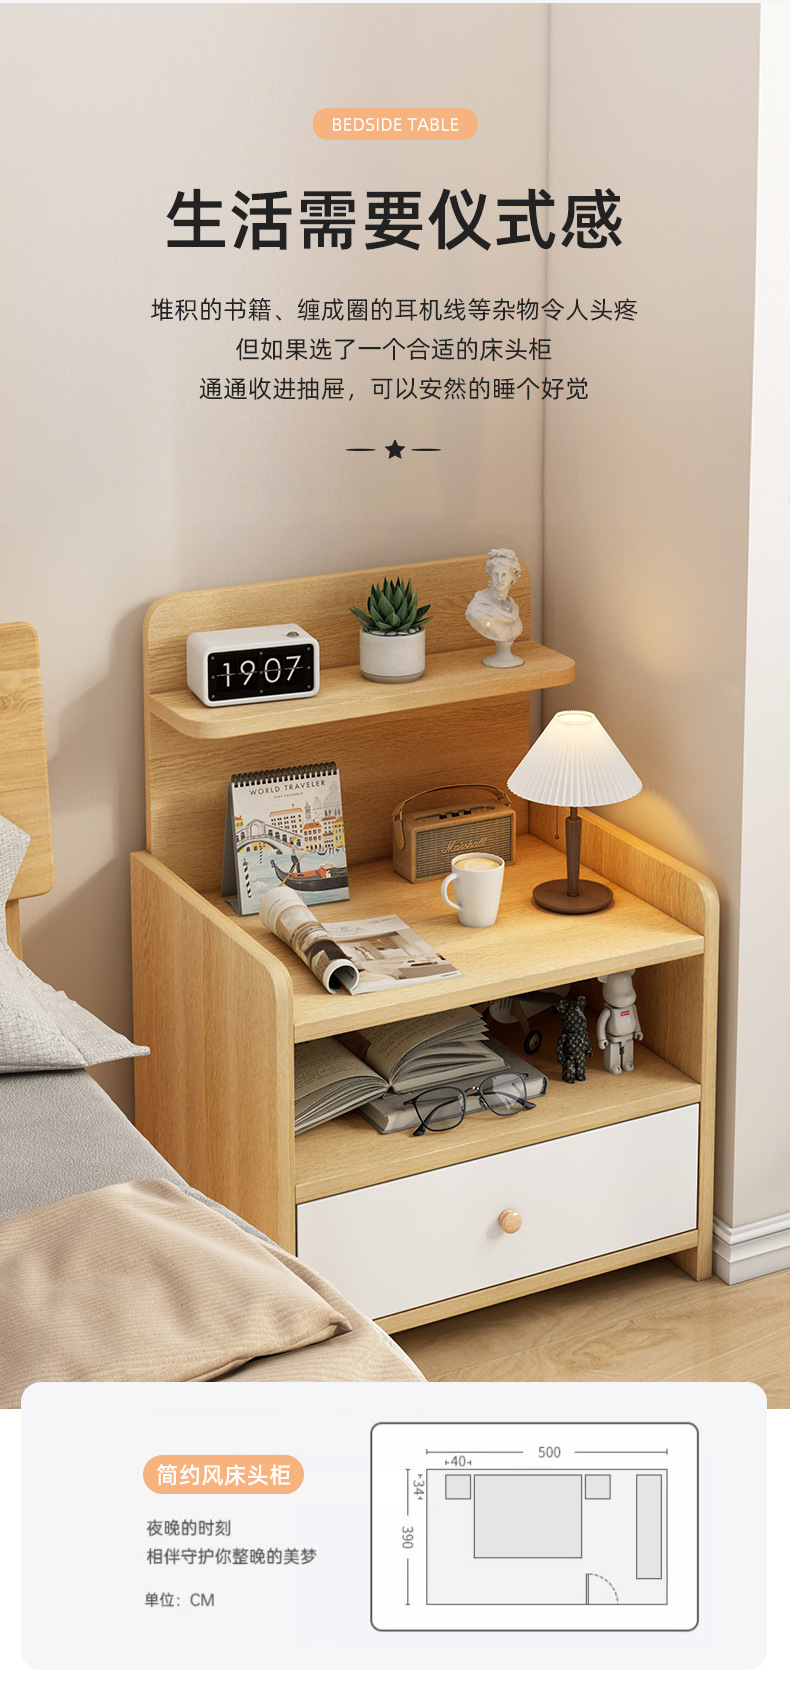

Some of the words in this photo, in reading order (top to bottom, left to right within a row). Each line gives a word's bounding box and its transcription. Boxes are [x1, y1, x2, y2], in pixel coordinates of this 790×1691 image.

[222, 655, 301, 687] 1907
[249, 785, 281, 796] WORLD
[284, 779, 326, 791] TRAVELER
[441, 837, 488, 854] Marshall
